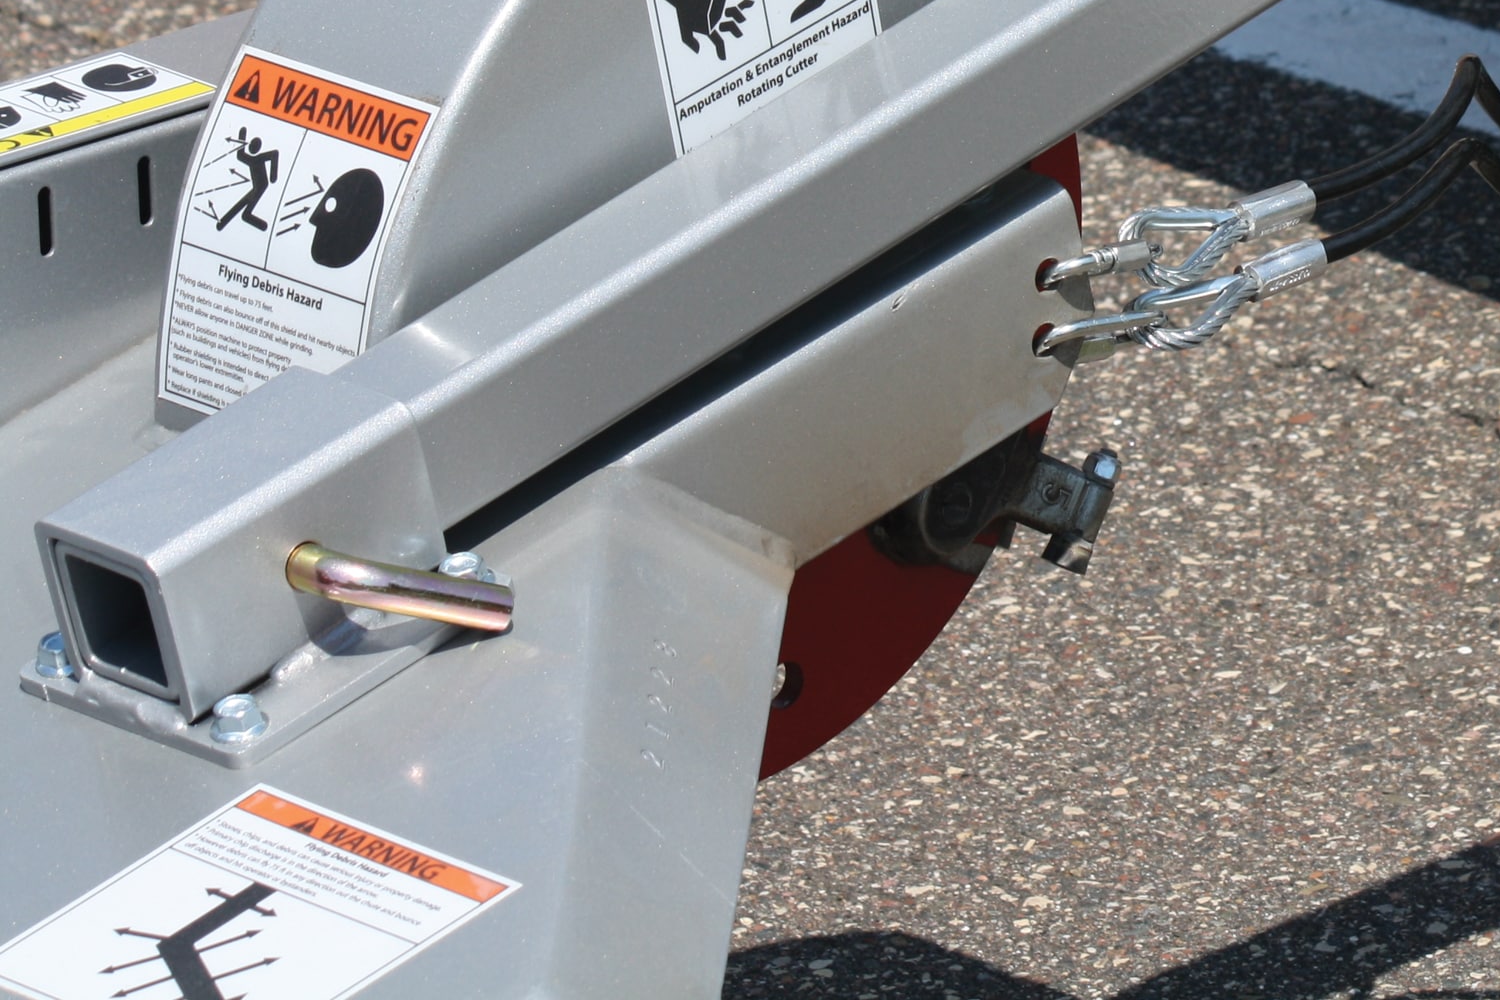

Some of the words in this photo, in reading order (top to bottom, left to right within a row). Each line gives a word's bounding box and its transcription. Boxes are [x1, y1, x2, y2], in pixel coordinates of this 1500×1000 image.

[679, 75, 743, 121] Amputation
[745, 70, 754, 81] &
[756, 25, 830, 76] Entanglement
[831, 0, 870, 33] Hazard
[737, 74, 784, 107] Rotating
[785, 52, 818, 79] Cutter
[272, 77, 418, 152] WARNING
[218, 264, 249, 288] Flying
[251, 275, 284, 297] Debris
[286, 287, 323, 310] Hazard
[305, 842, 331, 857] Flying
[330, 852, 357, 866] Debris
[357, 863, 389, 878] Hazard
[324, 823, 450, 880] WARNING
